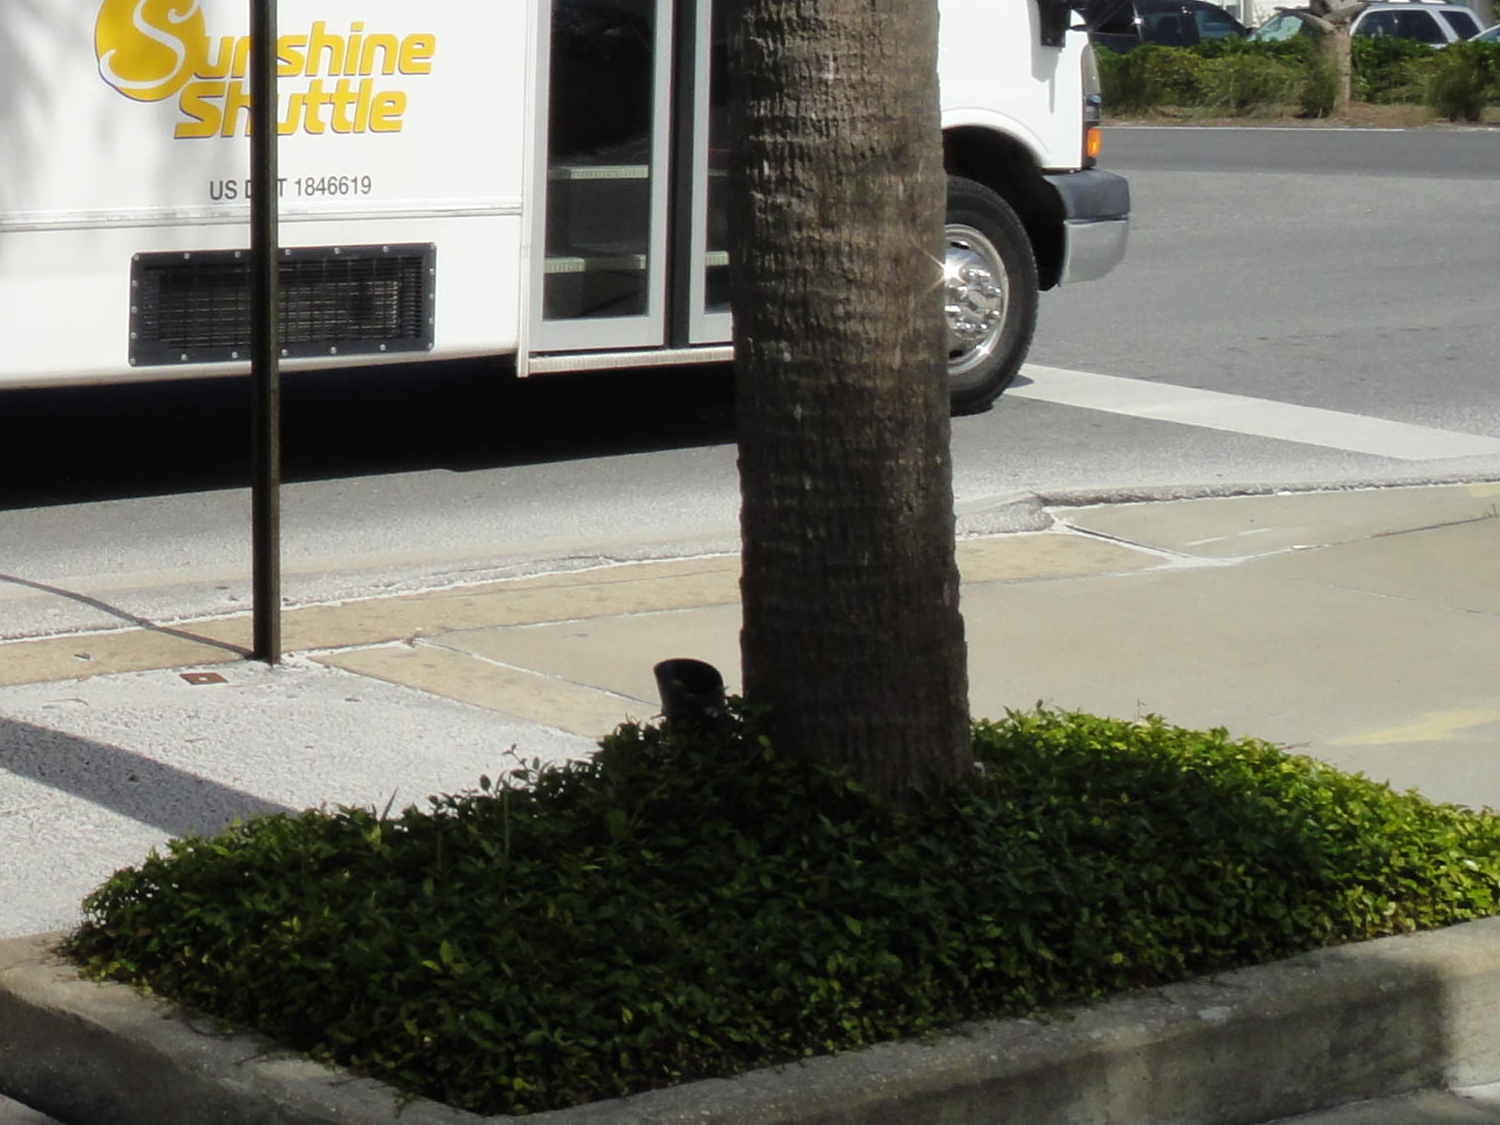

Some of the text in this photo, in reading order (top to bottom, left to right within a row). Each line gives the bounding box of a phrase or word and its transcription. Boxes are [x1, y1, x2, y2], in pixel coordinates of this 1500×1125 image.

[174, 78, 407, 139] Shuttle
[210, 180, 238, 201] US
[295, 175, 372, 197] 1846619
